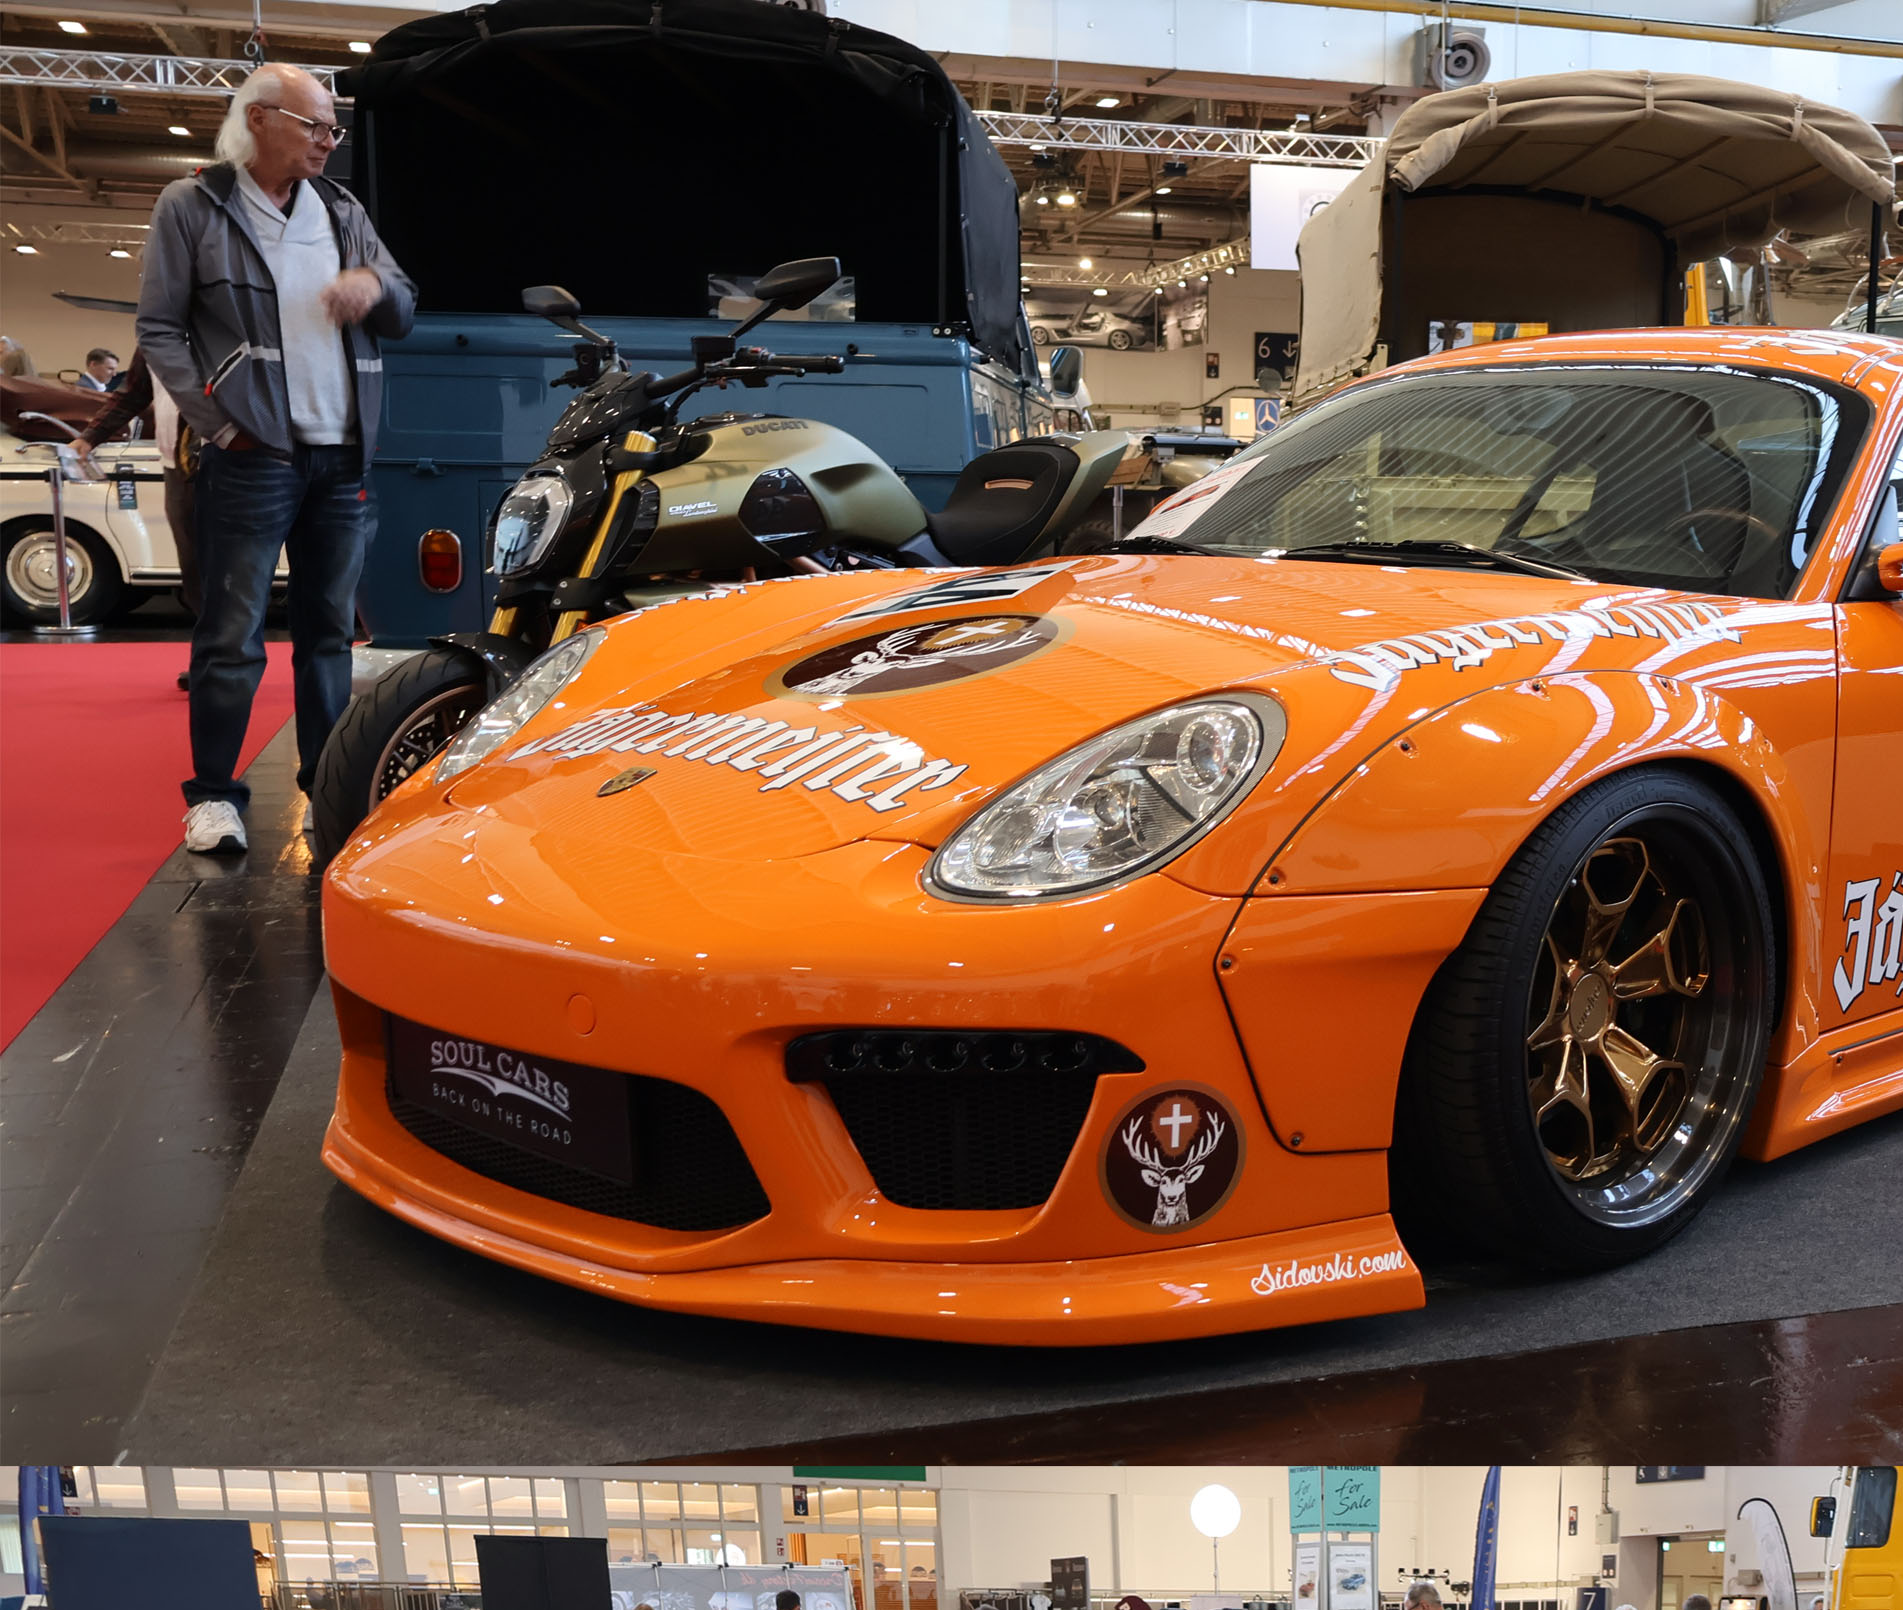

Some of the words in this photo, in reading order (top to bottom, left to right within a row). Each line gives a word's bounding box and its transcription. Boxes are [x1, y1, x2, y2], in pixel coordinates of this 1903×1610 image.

[1258, 337, 1271, 358] 6
[743, 420, 809, 436] DUCATI
[669, 501, 717, 513] DIAVEL
[431, 1041, 492, 1070] SOUL
[497, 1052, 570, 1112] CARS
[433, 1083, 466, 1107] BACK
[471, 1099, 491, 1117] ON
[497, 1107, 523, 1129] THE
[530, 1119, 572, 1145] ROAD
[1251, 1250, 1407, 1296] Sidovski.com
[1335, 1478, 1364, 1498] for
[1333, 1495, 1373, 1517] Sale
